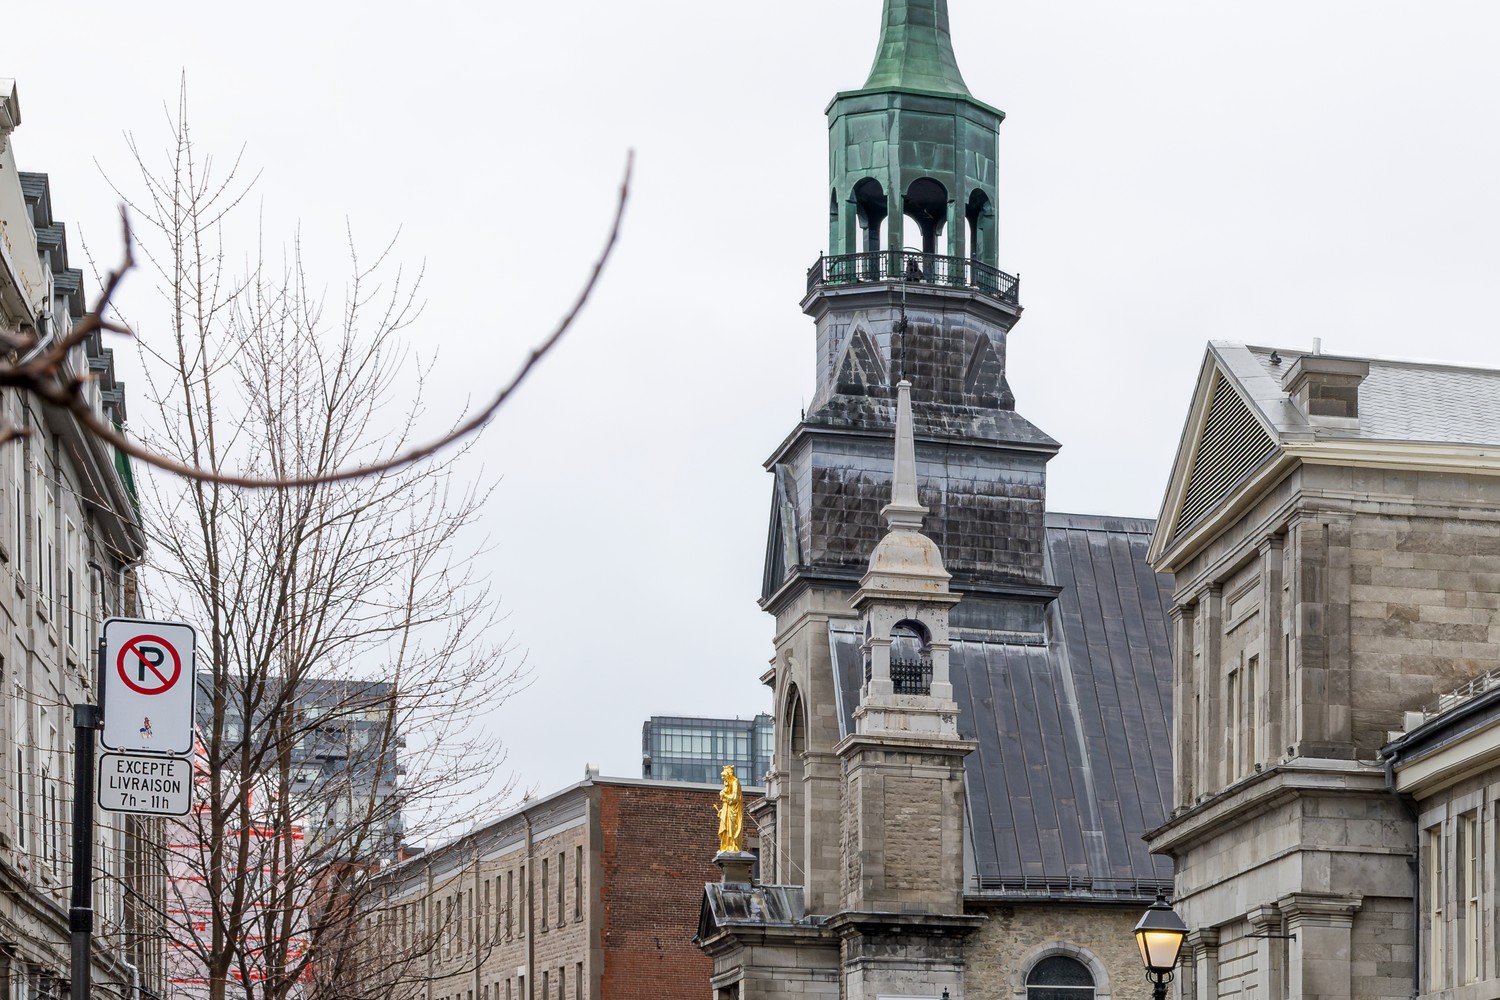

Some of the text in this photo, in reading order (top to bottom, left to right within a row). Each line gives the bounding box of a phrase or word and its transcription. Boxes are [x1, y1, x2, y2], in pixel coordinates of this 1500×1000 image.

[138, 646, 164, 682] P
[117, 760, 174, 777] EXCEPTÉ
[110, 776, 181, 793] LIVRAISON
[121, 793, 136, 807] 7h
[151, 795, 169, 809] 11h
